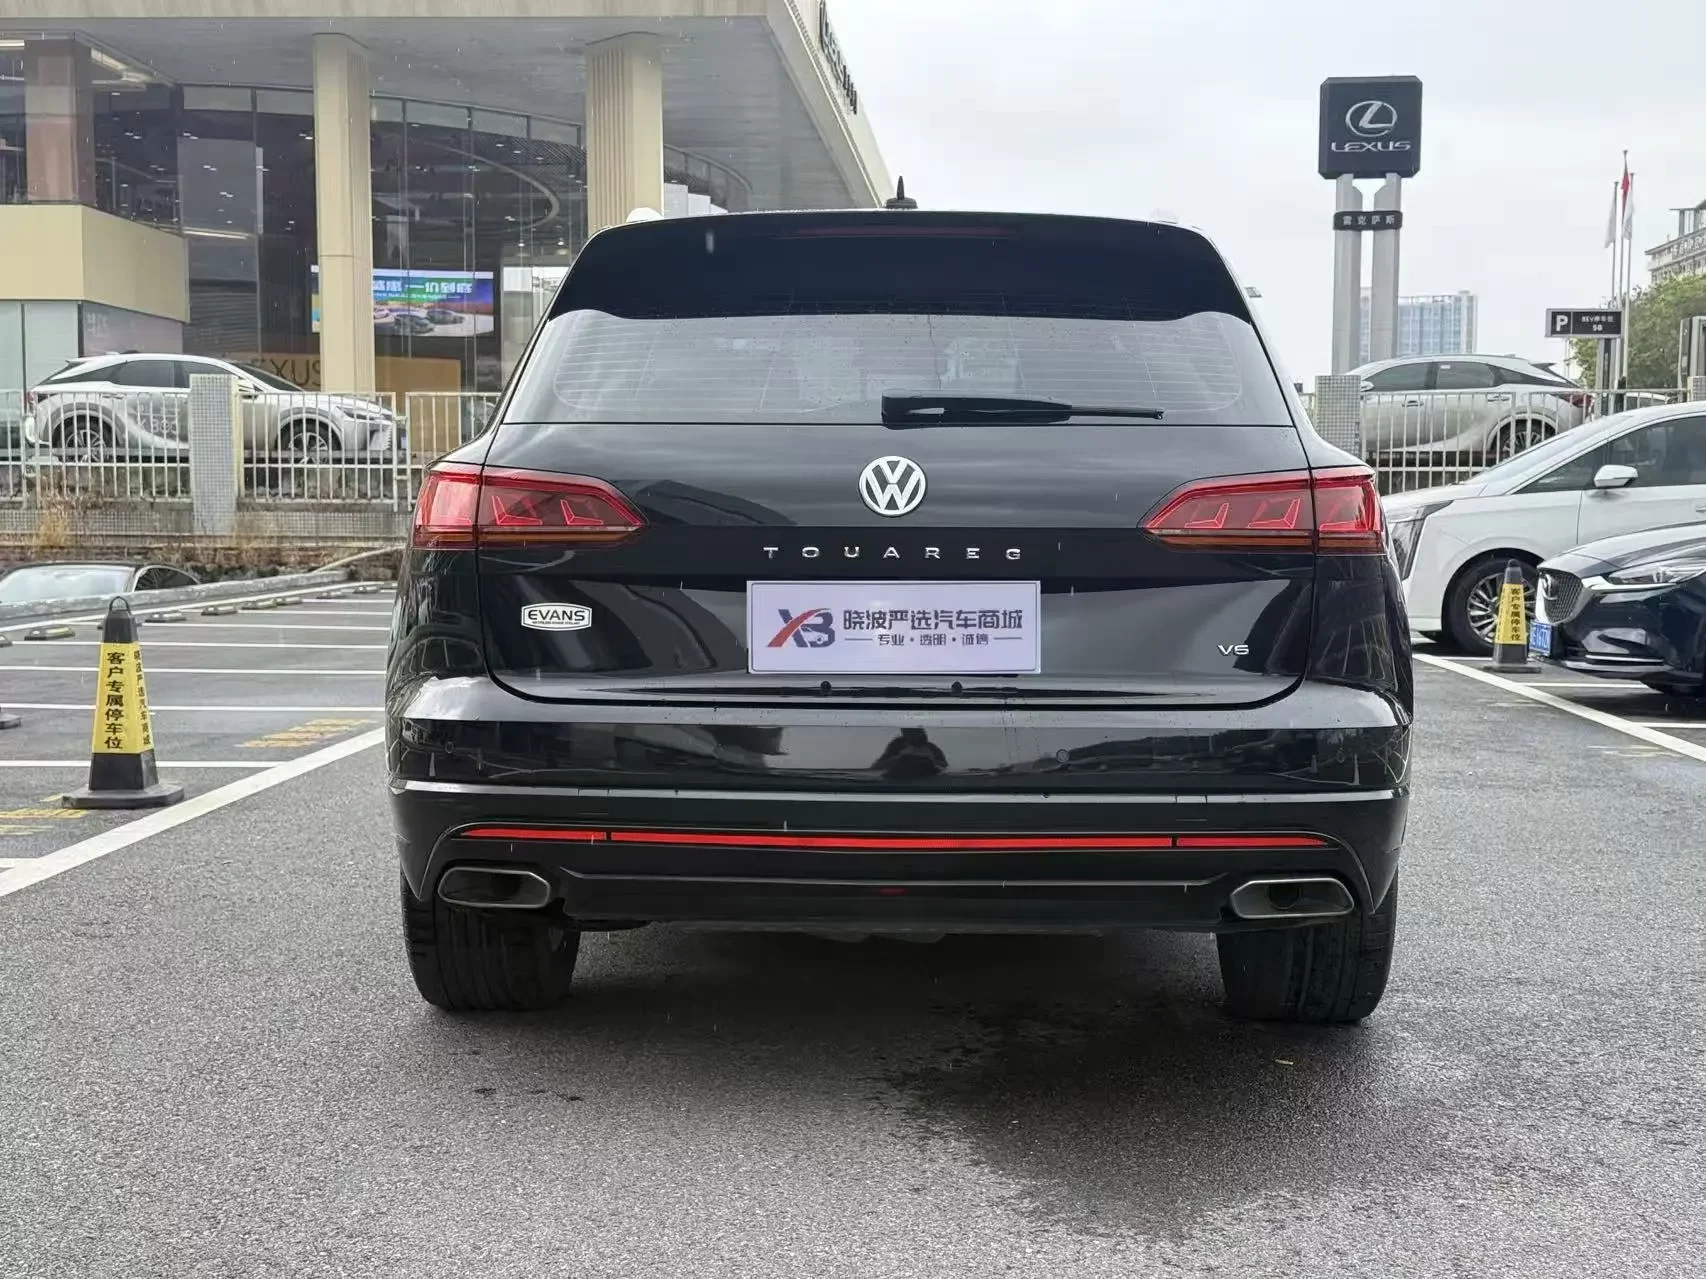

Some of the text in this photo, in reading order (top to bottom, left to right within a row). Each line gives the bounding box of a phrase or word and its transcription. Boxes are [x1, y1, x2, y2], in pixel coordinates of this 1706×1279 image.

[1331, 141, 1411, 152] LEXUS
[1343, 215, 1395, 226] 雷克萨斯
[1556, 315, 1568, 331] P
[763, 547, 1021, 560] TOUAREG
[528, 609, 586, 622] EVANS
[843, 609, 1023, 631] 晓波严选汽车商城
[1217, 644, 1250, 655] V6
[104, 651, 125, 749] 客户专属停车位
